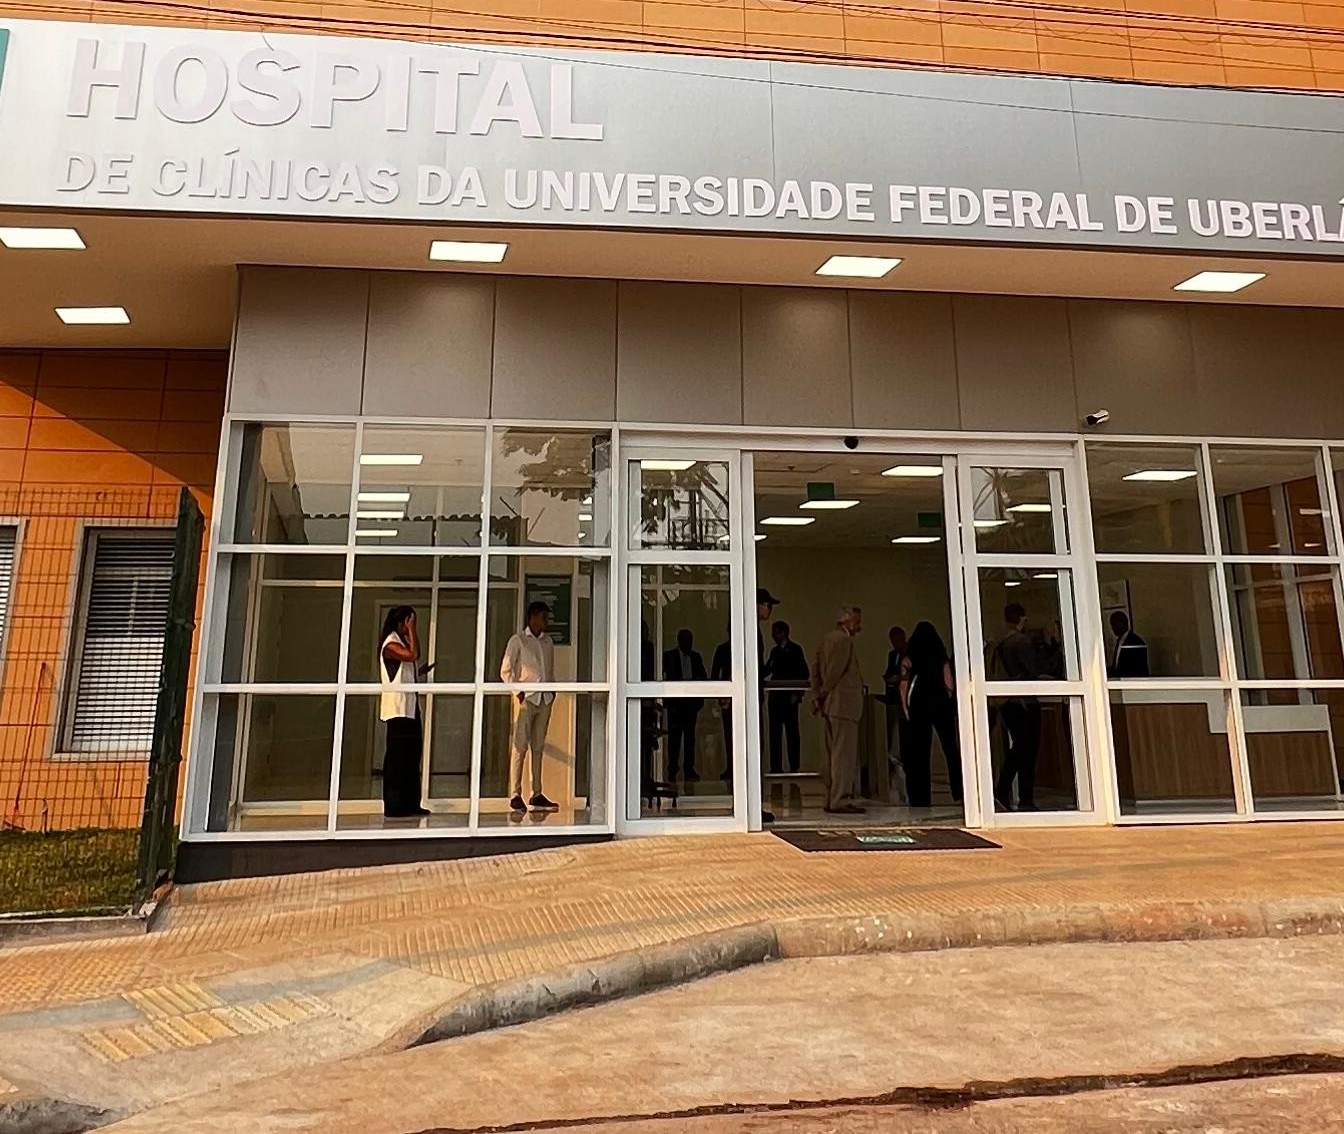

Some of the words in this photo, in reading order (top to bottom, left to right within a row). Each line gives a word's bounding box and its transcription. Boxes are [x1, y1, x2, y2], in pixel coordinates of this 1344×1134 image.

[65, 38, 605, 141] HOSPITAL
[56, 152, 134, 195] DE
[151, 147, 401, 205] CLÍNICAS
[416, 165, 489, 209] DA
[503, 168, 876, 223] UNIVERSIDADE
[888, 184, 1104, 232] FEDERAL
[1114, 194, 1178, 235] DE
